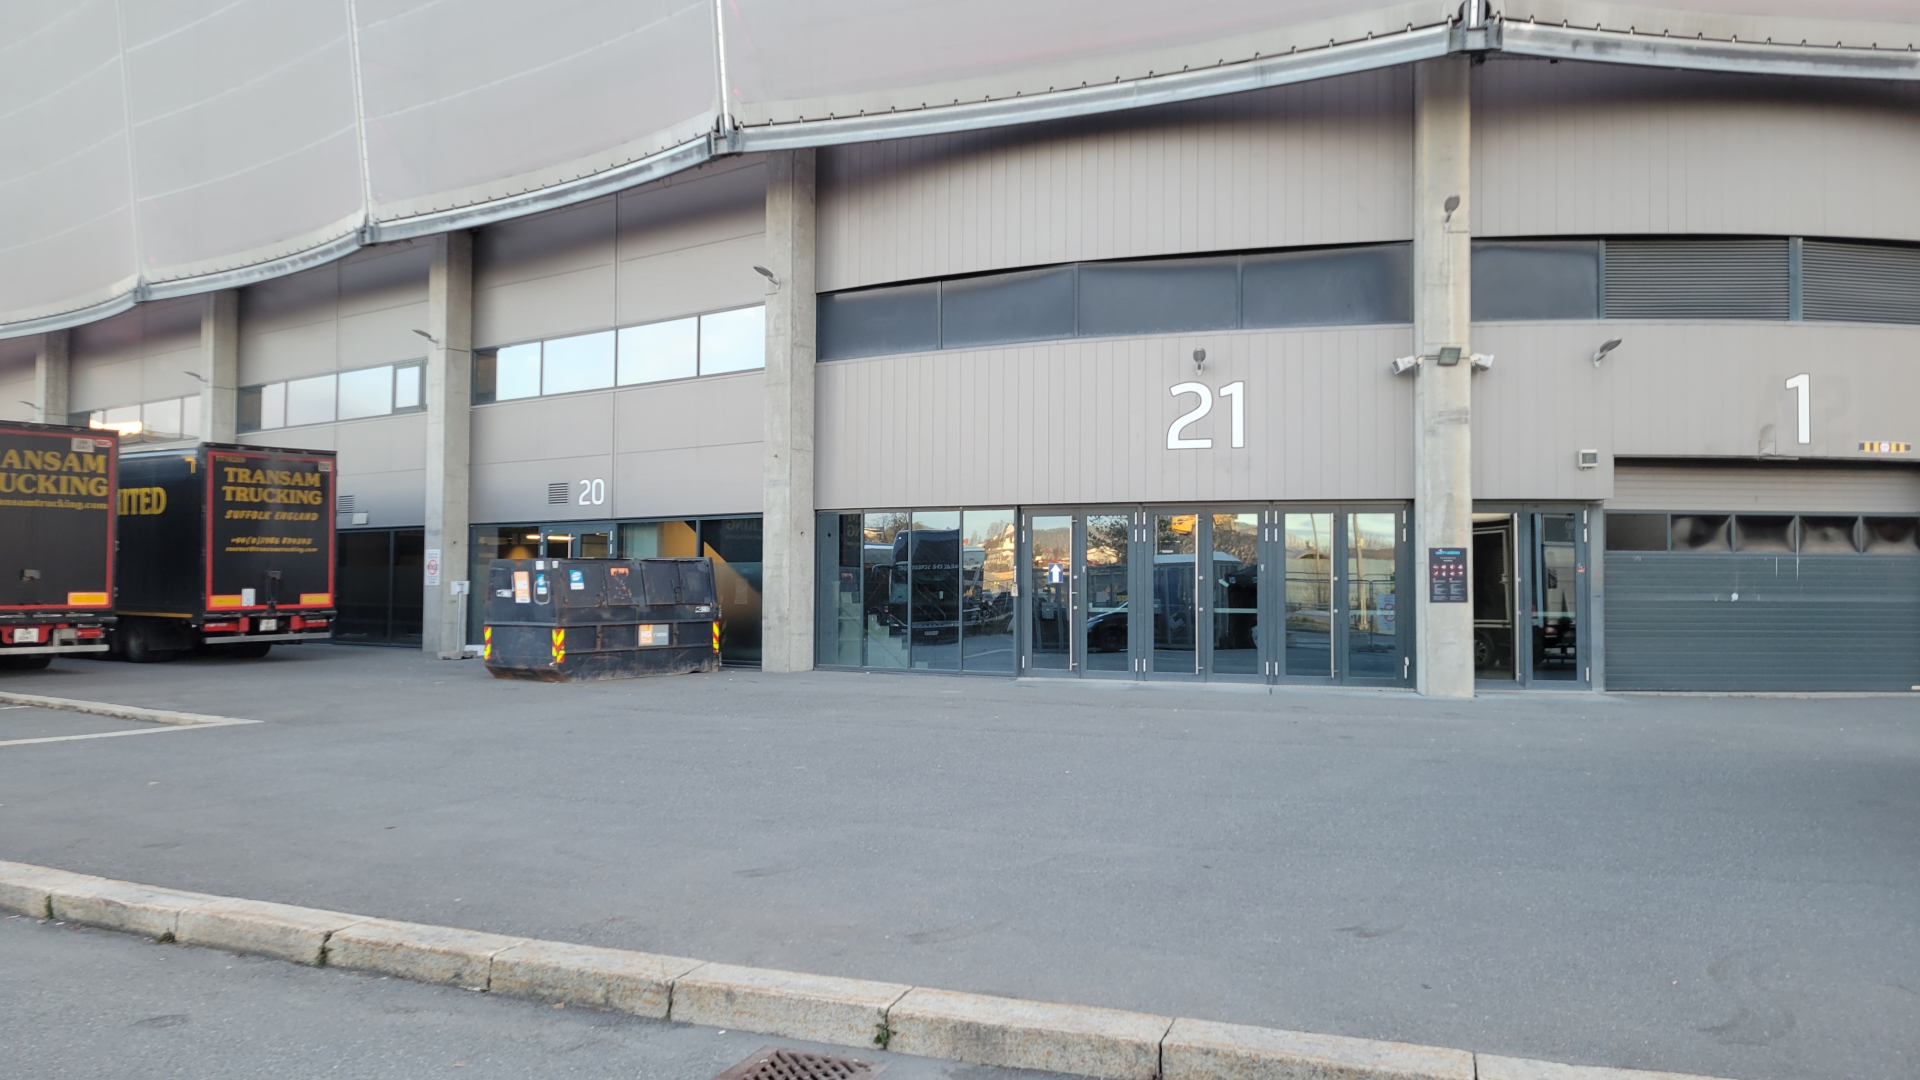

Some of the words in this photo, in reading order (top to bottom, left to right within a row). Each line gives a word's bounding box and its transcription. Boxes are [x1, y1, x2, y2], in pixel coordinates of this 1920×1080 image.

[1166, 381, 1244, 450] 21
[1785, 373, 1810, 444] 1
[0, 449, 107, 474] ANSAM
[223, 466, 321, 487] TRANSAM
[221, 485, 323, 505] TRUCKING
[578, 478, 605, 506] 20
[274, 511, 319, 521] ENGLAND
